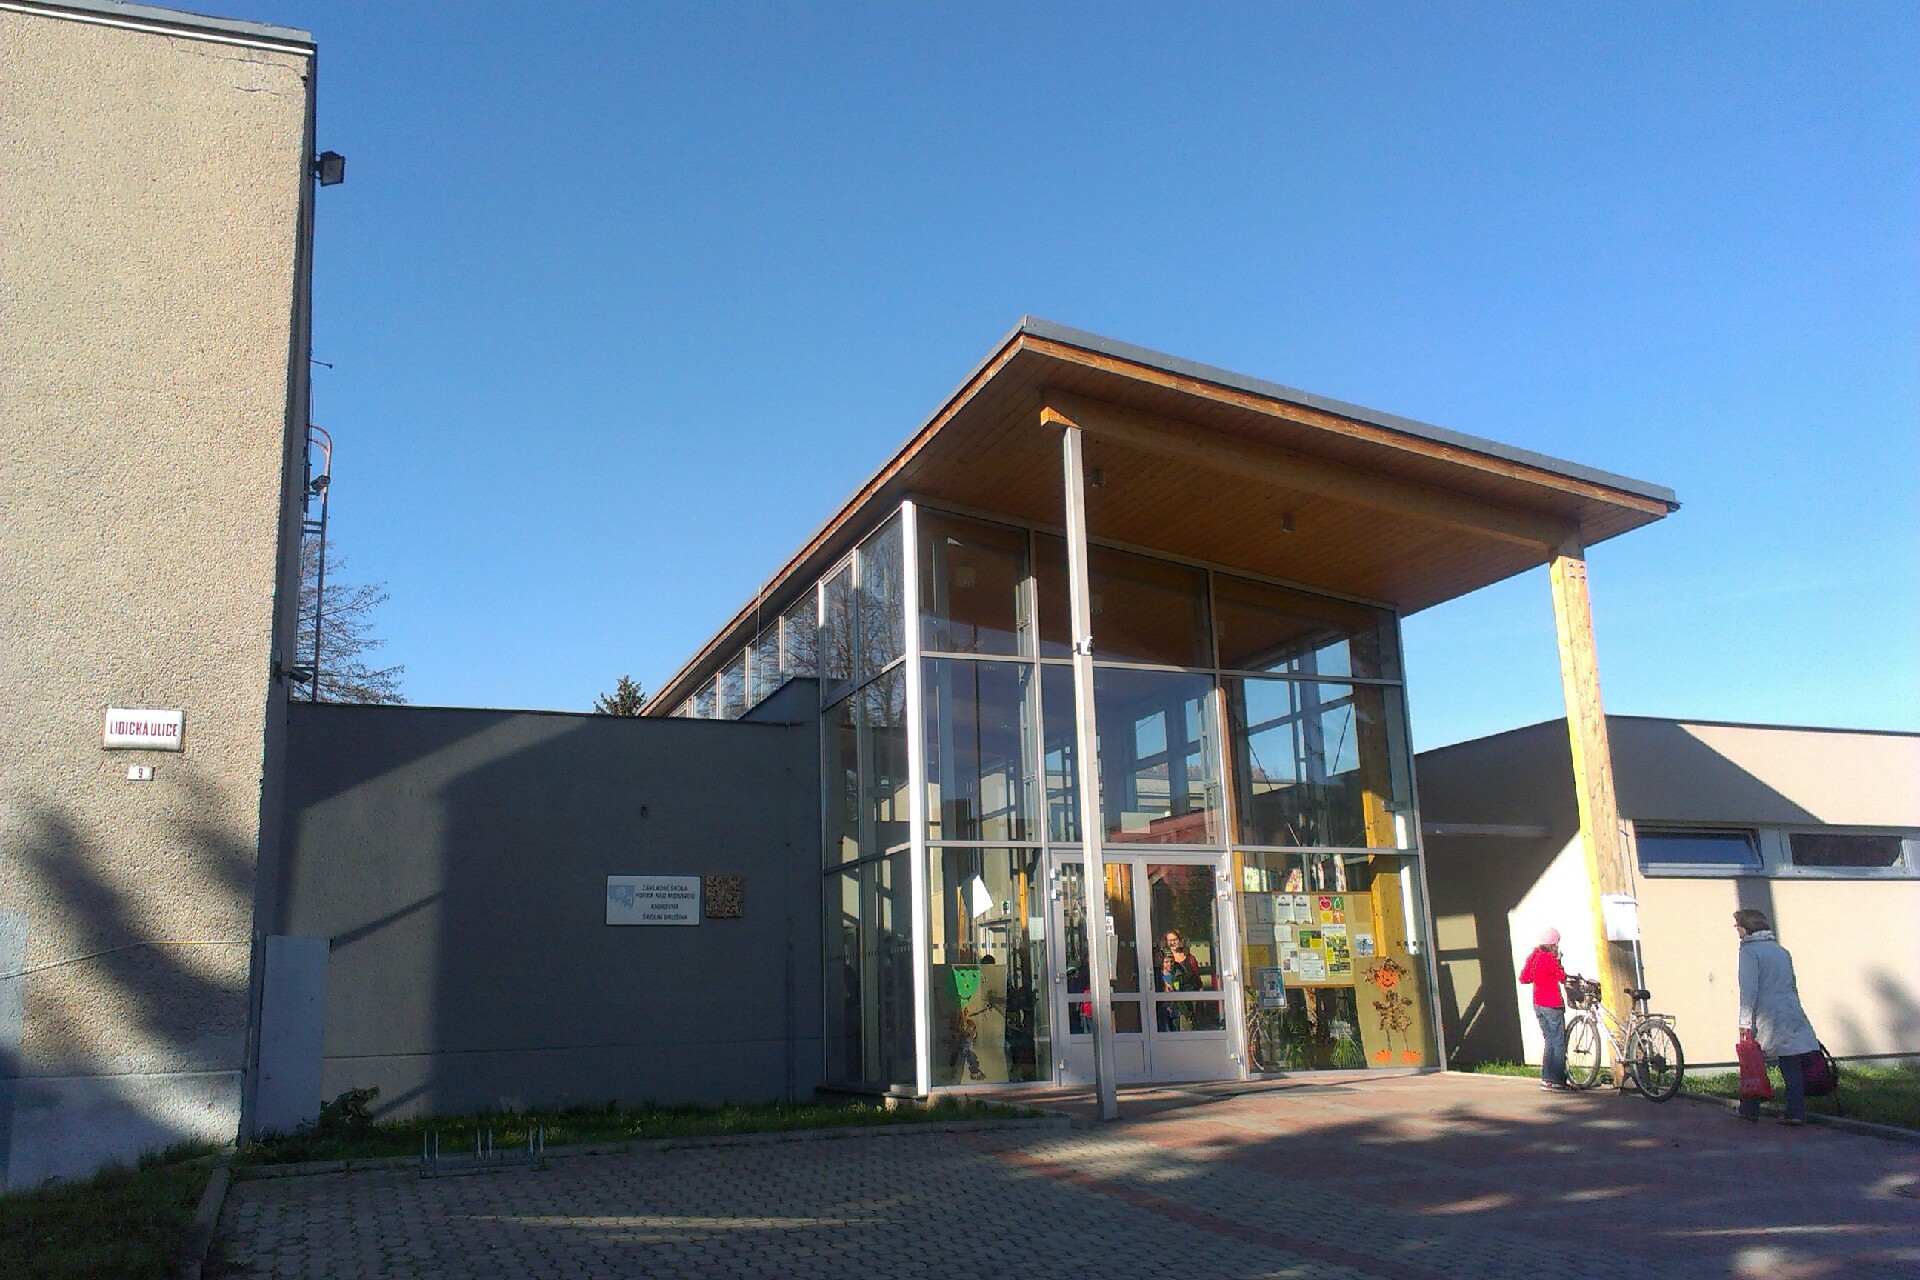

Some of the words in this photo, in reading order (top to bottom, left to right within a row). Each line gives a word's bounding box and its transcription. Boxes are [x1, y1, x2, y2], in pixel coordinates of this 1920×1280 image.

[110, 720, 148, 736] LIDICKÁ
[151, 723, 178, 736] ULICE
[138, 767, 143, 778] 9
